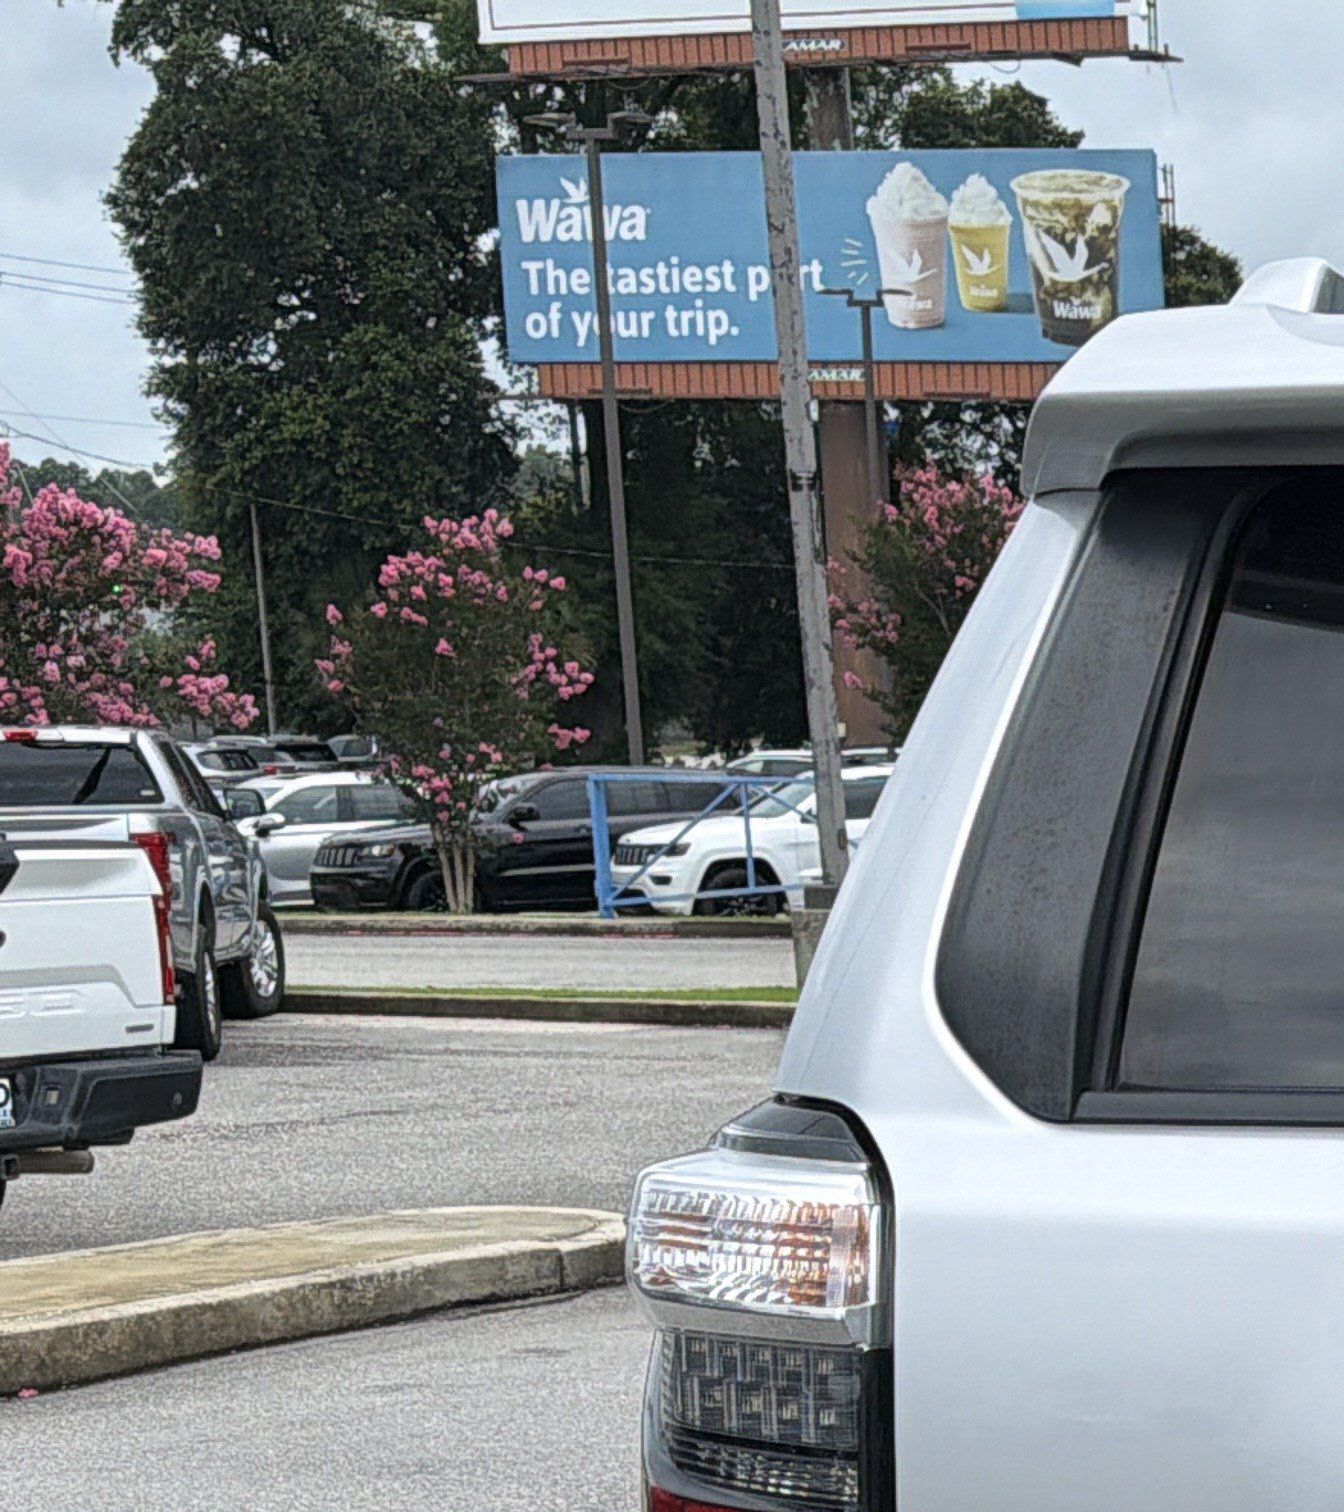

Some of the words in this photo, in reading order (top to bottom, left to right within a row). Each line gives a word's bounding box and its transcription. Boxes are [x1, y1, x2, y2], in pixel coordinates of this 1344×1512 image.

[515, 197, 648, 243] Wawa
[521, 258, 591, 295] The
[605, 256, 737, 295] tastiest
[747, 258, 825, 302] prt
[525, 302, 562, 339] of
[664, 299, 740, 345] trip.
